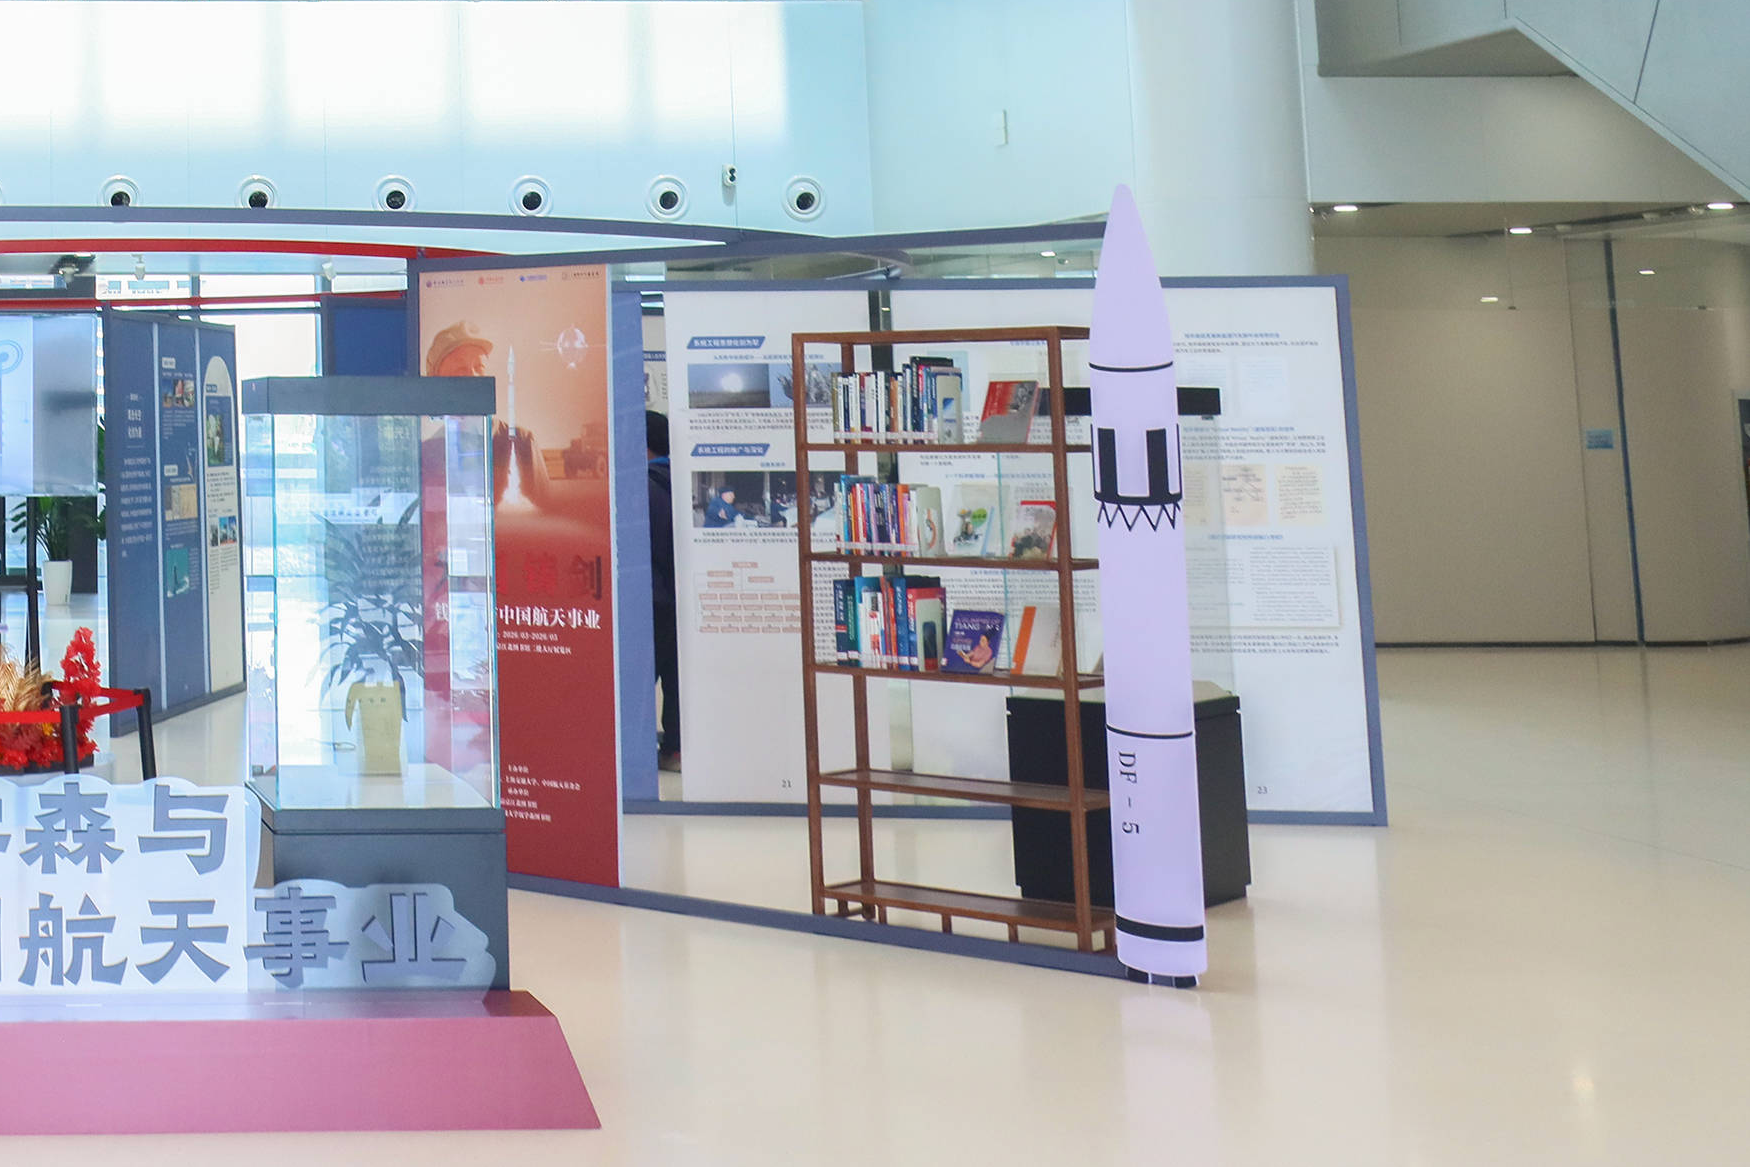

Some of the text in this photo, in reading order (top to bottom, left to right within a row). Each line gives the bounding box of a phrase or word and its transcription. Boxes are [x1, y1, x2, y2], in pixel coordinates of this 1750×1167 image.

[496, 605, 601, 629] 中国航天事业
